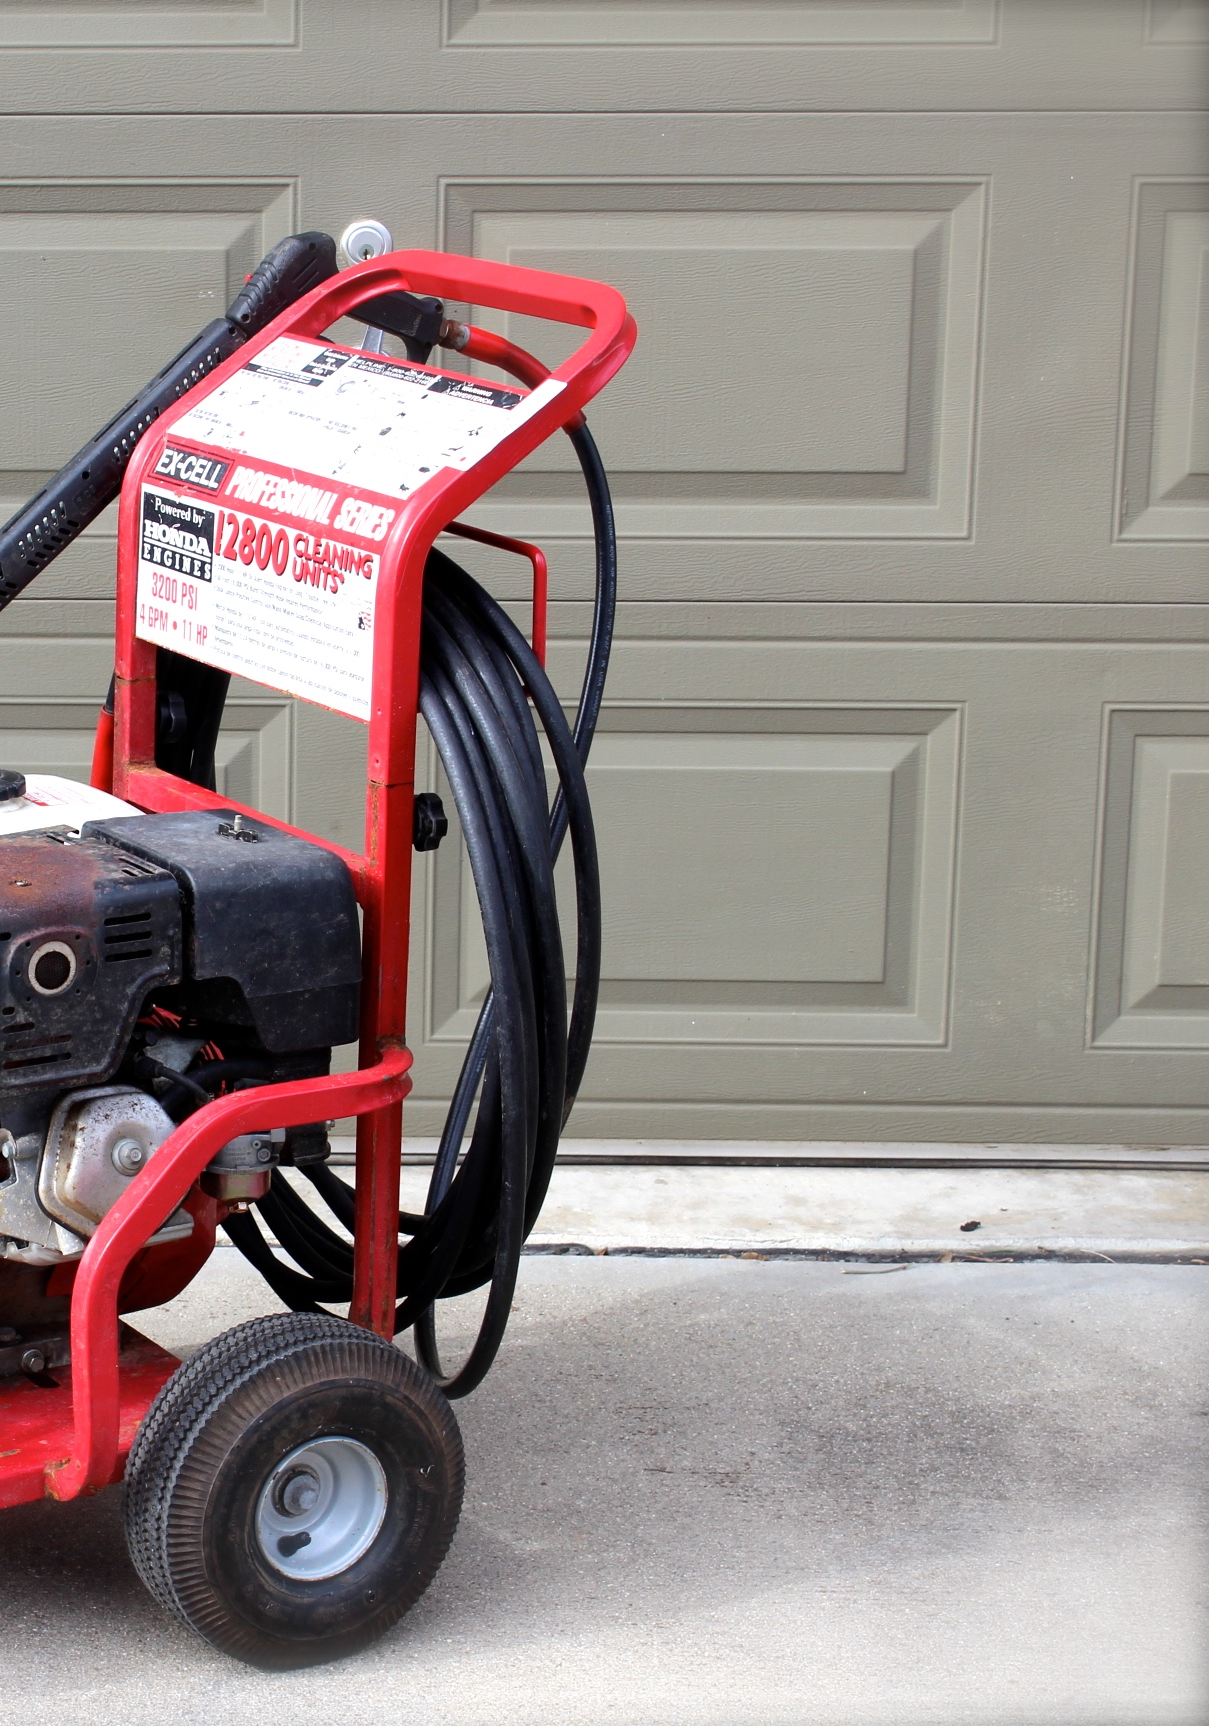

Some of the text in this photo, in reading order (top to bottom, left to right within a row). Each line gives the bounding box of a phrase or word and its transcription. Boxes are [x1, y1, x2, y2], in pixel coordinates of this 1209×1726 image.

[154, 448, 221, 489] EX-CELL
[154, 497, 205, 527] Powered by
[225, 465, 396, 541] PROFESSIONAL SERIES
[143, 519, 212, 558] HONDA
[214, 510, 289, 576] 12800
[293, 533, 373, 579] CLEANING
[143, 543, 211, 580] ENGINES
[152, 572, 177, 604] 3200
[181, 583, 198, 611] PSI
[140, 604, 208, 646] 4 GPM 11 HP
